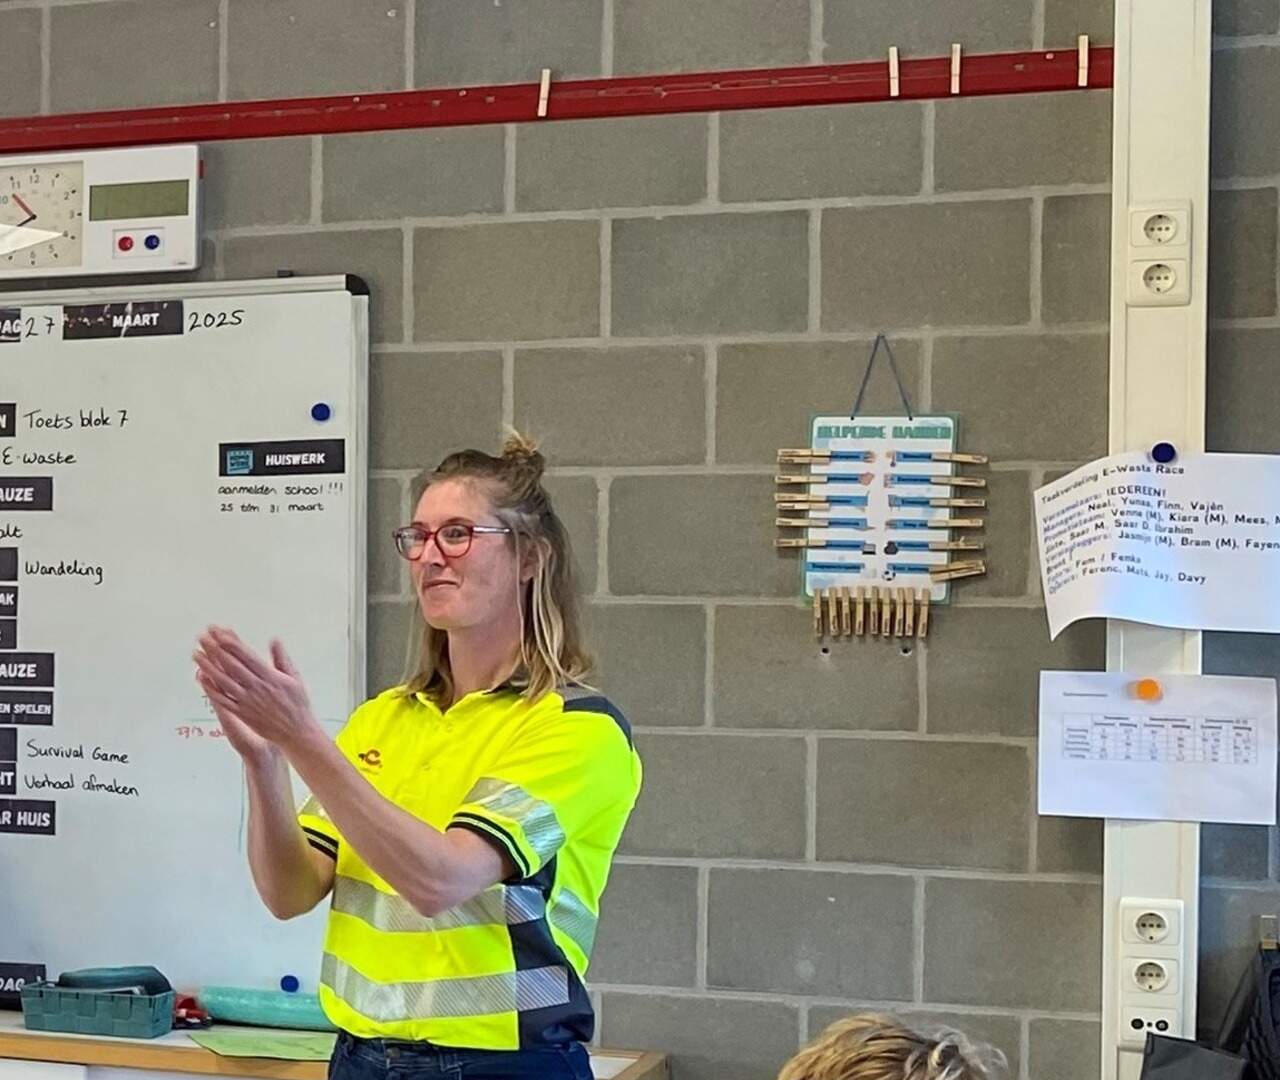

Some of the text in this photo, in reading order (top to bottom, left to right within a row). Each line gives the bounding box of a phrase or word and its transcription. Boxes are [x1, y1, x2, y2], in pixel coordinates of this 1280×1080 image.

[11, 180, 21, 190] 11
[29, 174, 40, 185] 12
[63, 191, 71, 201] 2
[112, 312, 161, 328] MAART
[188, 308, 246, 331] 2025
[23, 406, 129, 430] Toets blok 7
[265, 452, 326, 467] HUISWERK
[1155, 464, 1185, 475] Race
[284, 484, 324, 496] school
[287, 502, 325, 513] maart
[1169, 512, 1200, 522] Kiara
[24, 559, 104, 586] Wandeling
[1177, 571, 1207, 585] Davy
[13, 703, 53, 716] SPELEN
[26, 737, 130, 765] Survival Game
[81, 774, 140, 798] afmaken
[16, 811, 52, 828] HUIS
